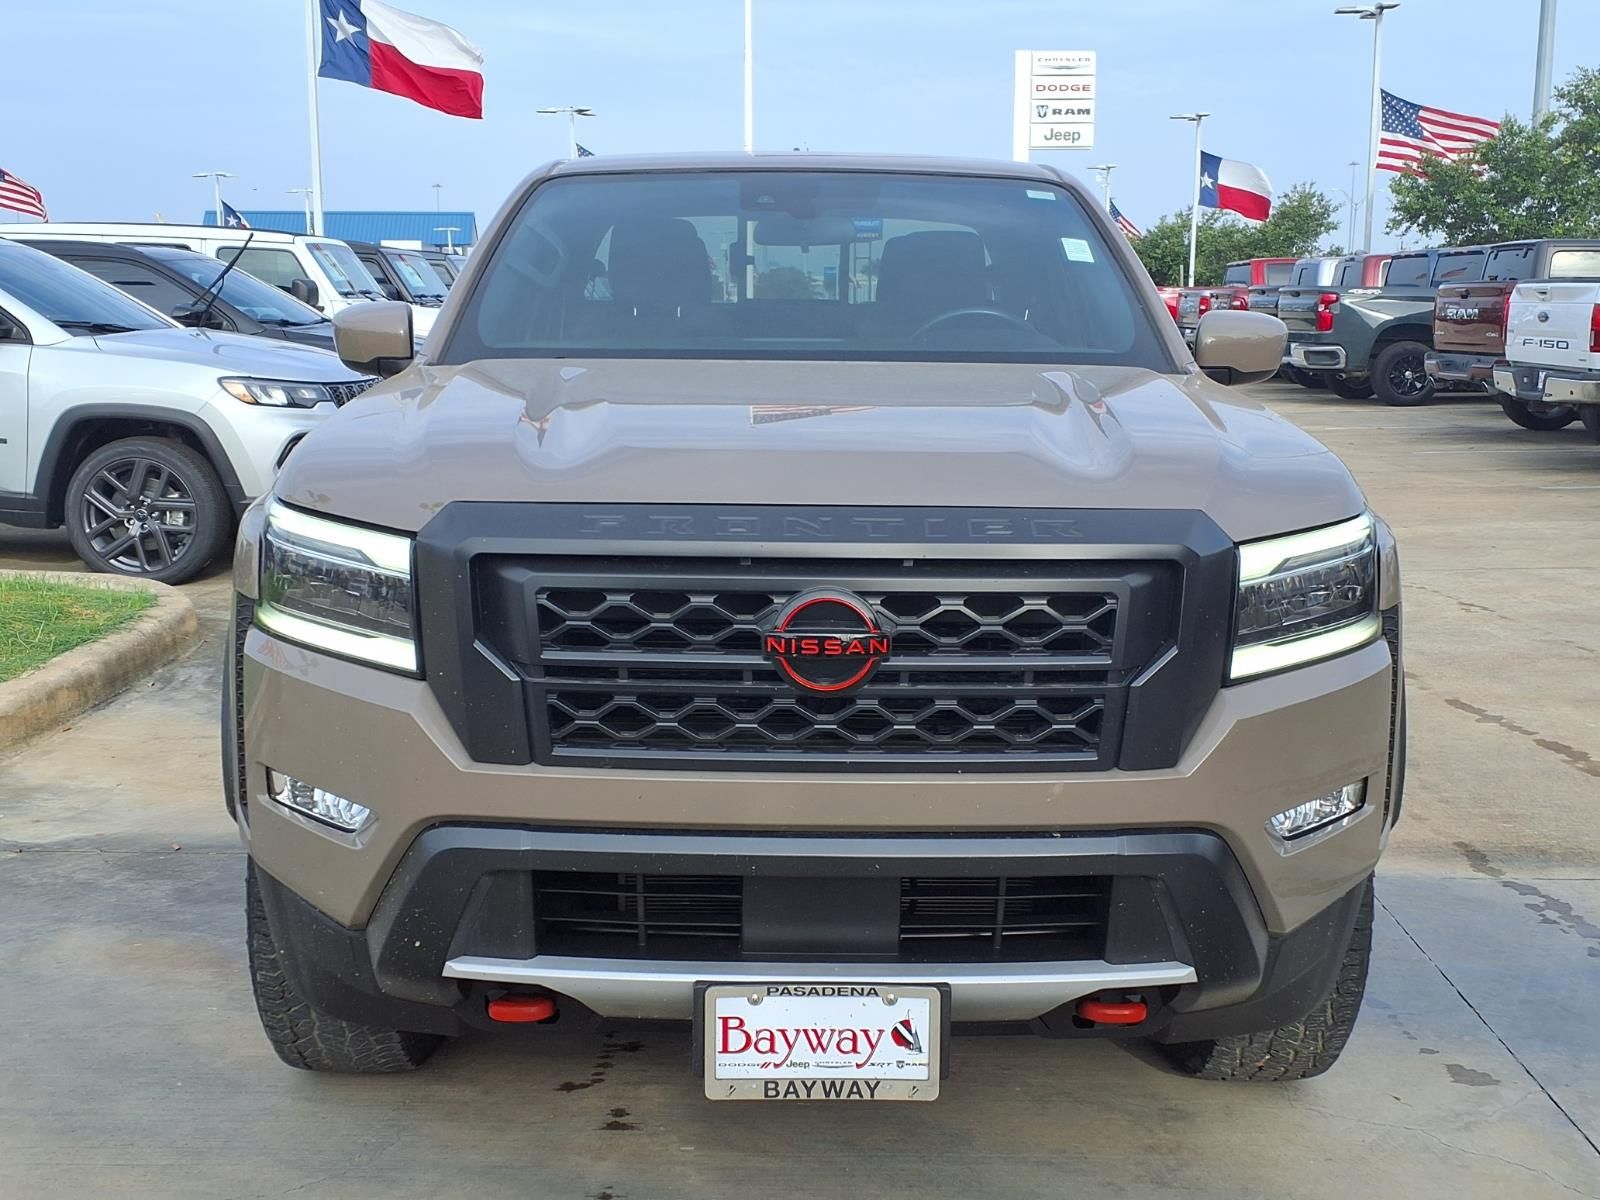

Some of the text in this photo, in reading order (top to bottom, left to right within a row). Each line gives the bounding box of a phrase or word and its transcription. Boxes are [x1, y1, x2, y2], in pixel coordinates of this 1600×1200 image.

[1036, 84, 1091, 92] DODGE
[1052, 108, 1091, 116] RAM
[1043, 127, 1081, 144] Jeep
[1446, 308, 1479, 320] RAM
[1522, 338, 1569, 350] F-150
[579, 514, 1083, 541] FRONTIER
[766, 636, 889, 656] NISSAN
[767, 986, 880, 997] PASADENA
[717, 1016, 886, 1070] Bayway
[785, 1059, 810, 1069] Jeep
[763, 1080, 881, 1099] BAYWAY
